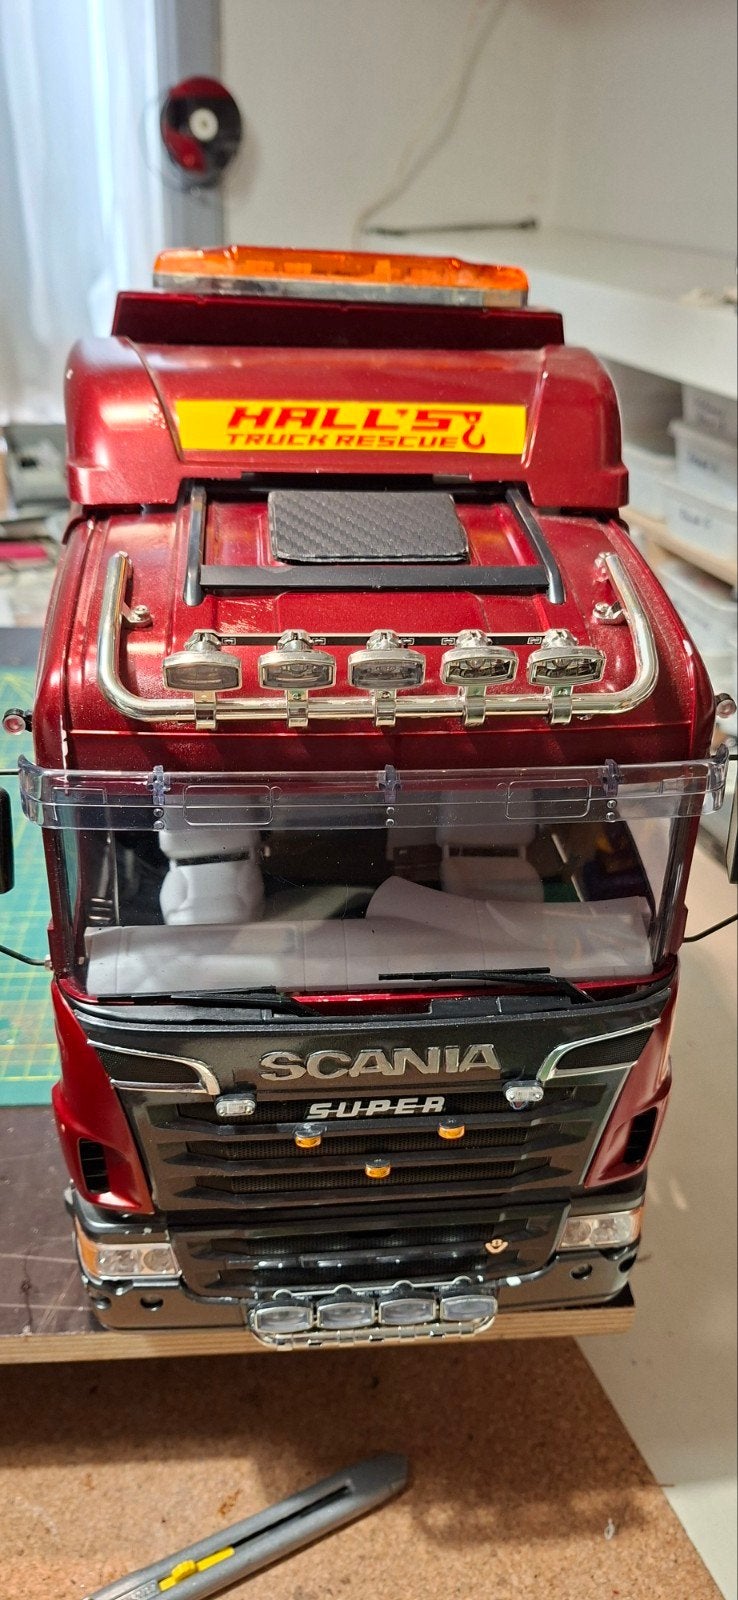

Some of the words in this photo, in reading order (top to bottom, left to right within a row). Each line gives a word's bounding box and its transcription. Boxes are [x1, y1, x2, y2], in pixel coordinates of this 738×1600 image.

[228, 407, 453, 430] HALL'S
[228, 433, 328, 446] TRUCK
[335, 435, 458, 448] RESCUE
[260, 1043, 501, 1081] SCANIA
[307, 1096, 446, 1119] SUPER
